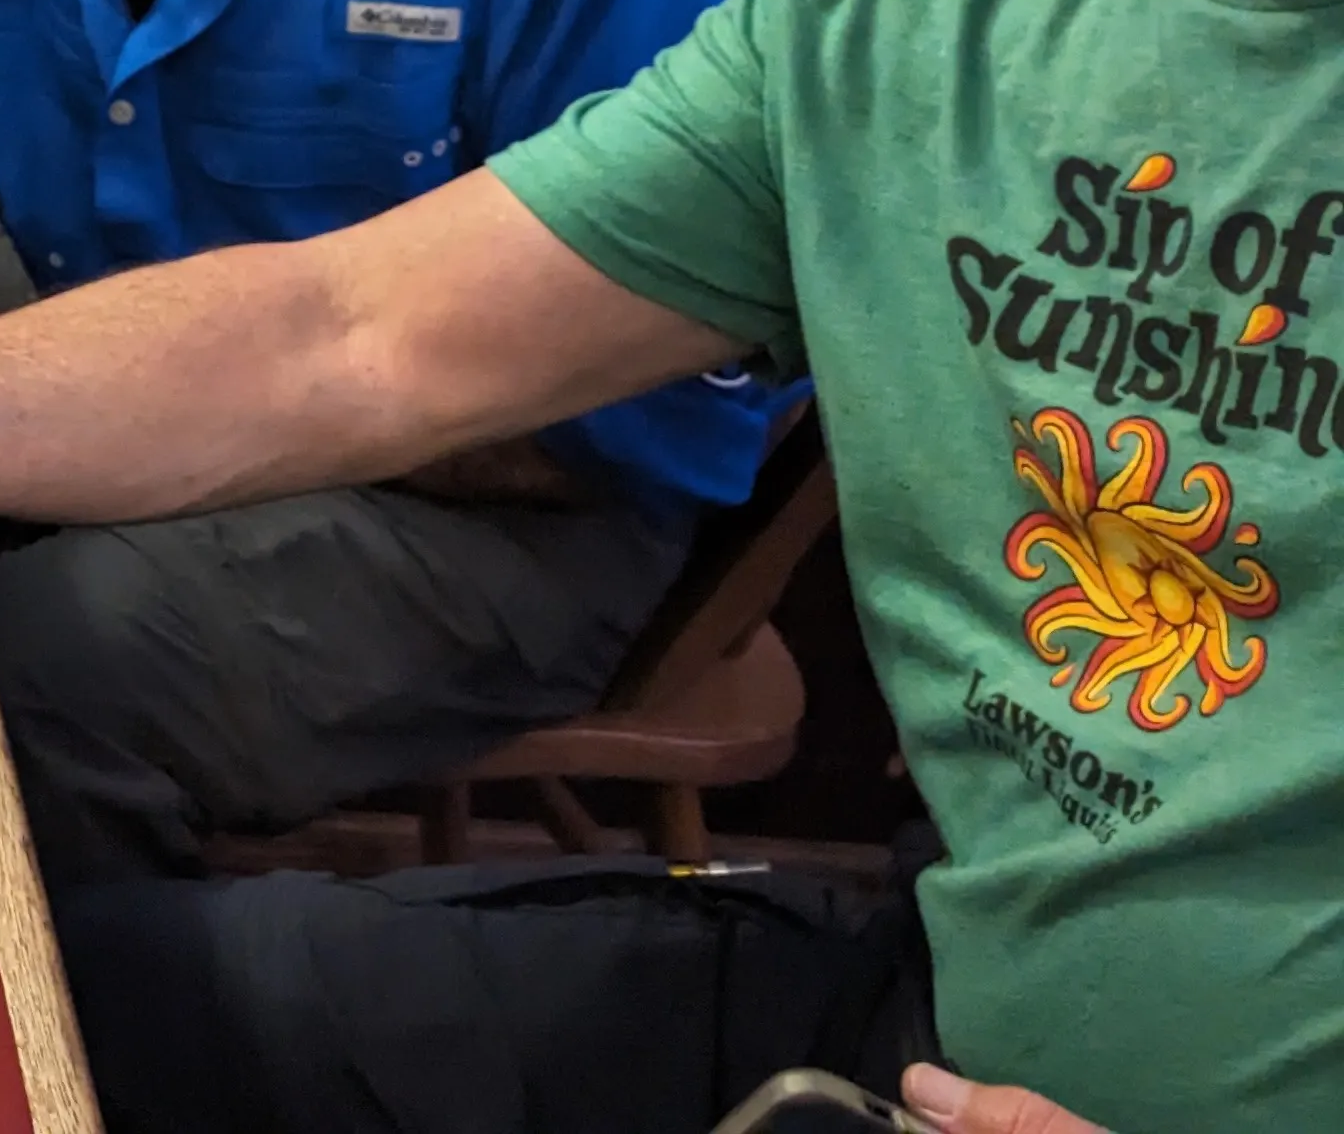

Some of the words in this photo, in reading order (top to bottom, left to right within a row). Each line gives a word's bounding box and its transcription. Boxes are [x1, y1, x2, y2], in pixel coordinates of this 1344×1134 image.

[1036, 152, 1194, 304] Sip
[1209, 191, 1344, 316] of
[963, 669, 1163, 825] Lawson's
